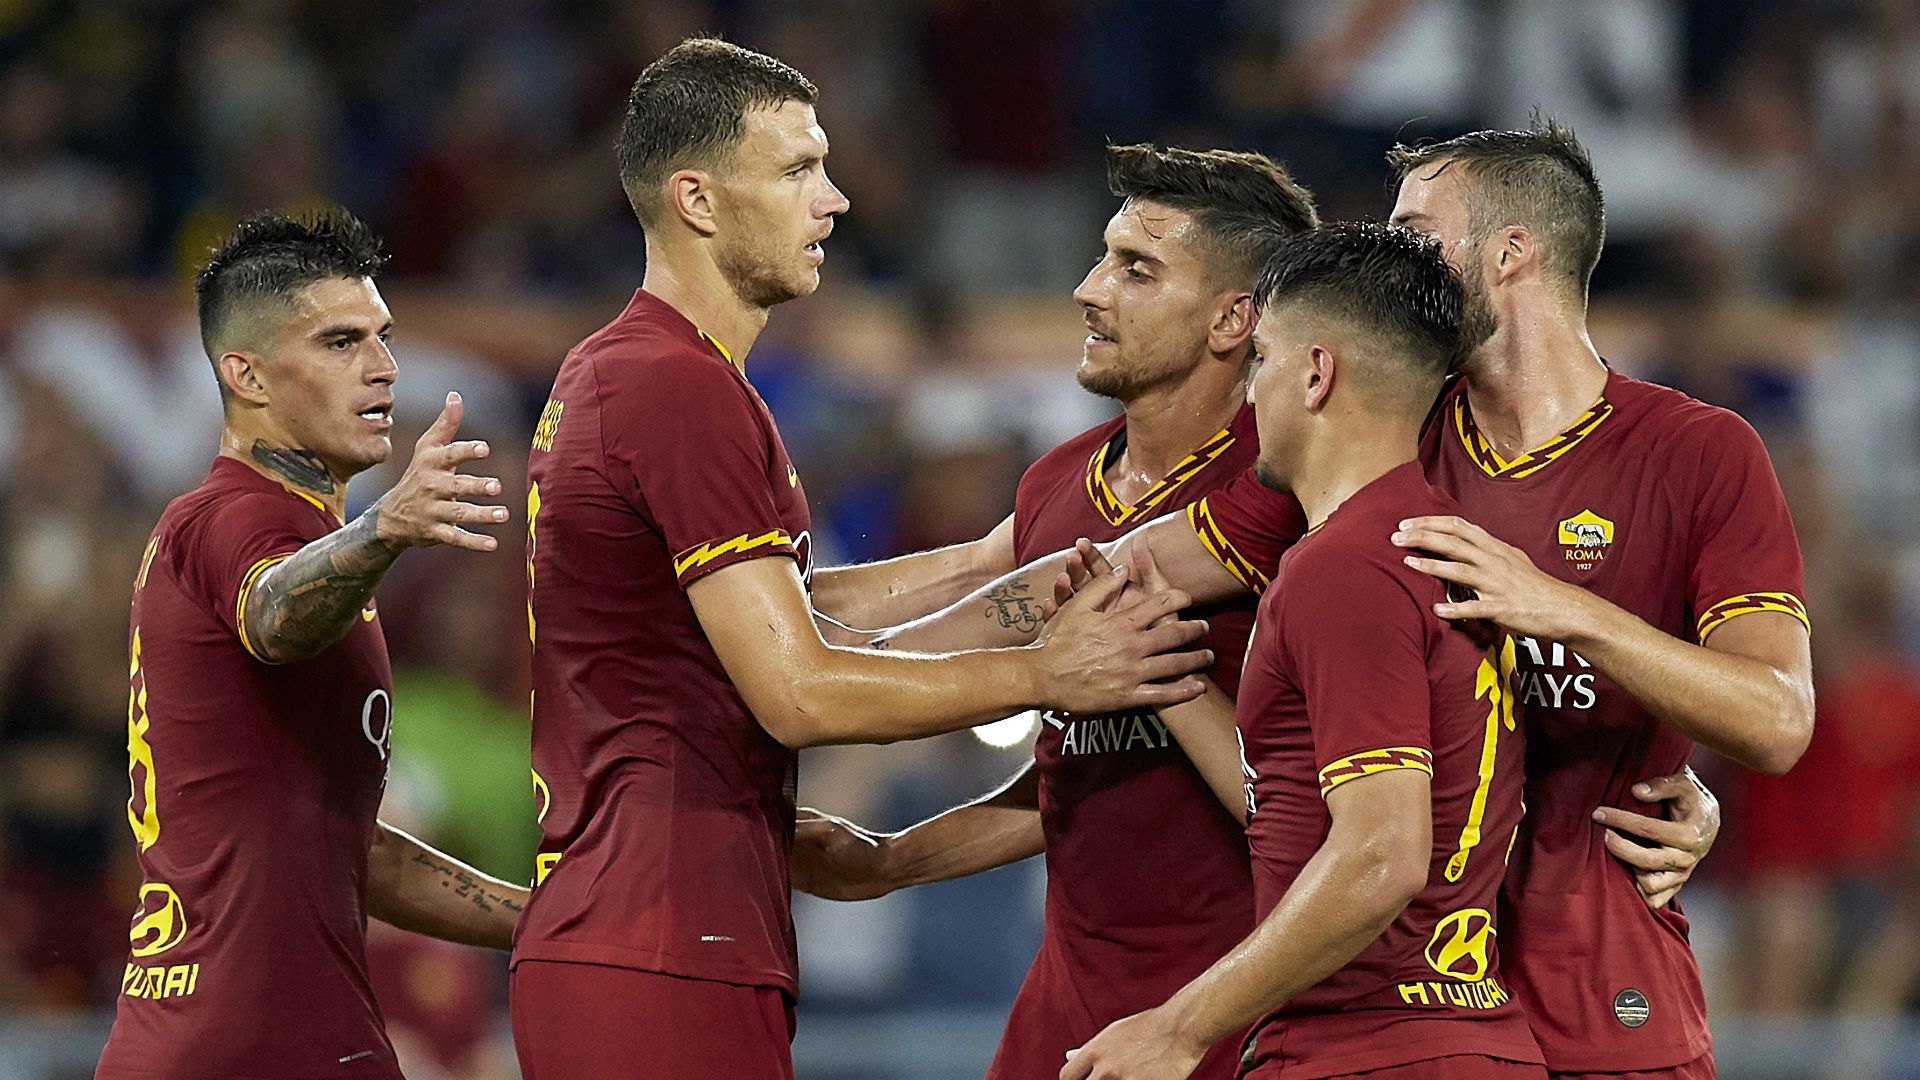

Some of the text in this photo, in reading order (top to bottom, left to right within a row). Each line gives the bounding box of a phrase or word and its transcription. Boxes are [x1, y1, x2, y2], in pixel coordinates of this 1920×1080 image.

[1565, 549, 1604, 560] ROMA
[1520, 671, 1596, 709] AYS
[1061, 713, 1169, 756] AIRWAY
